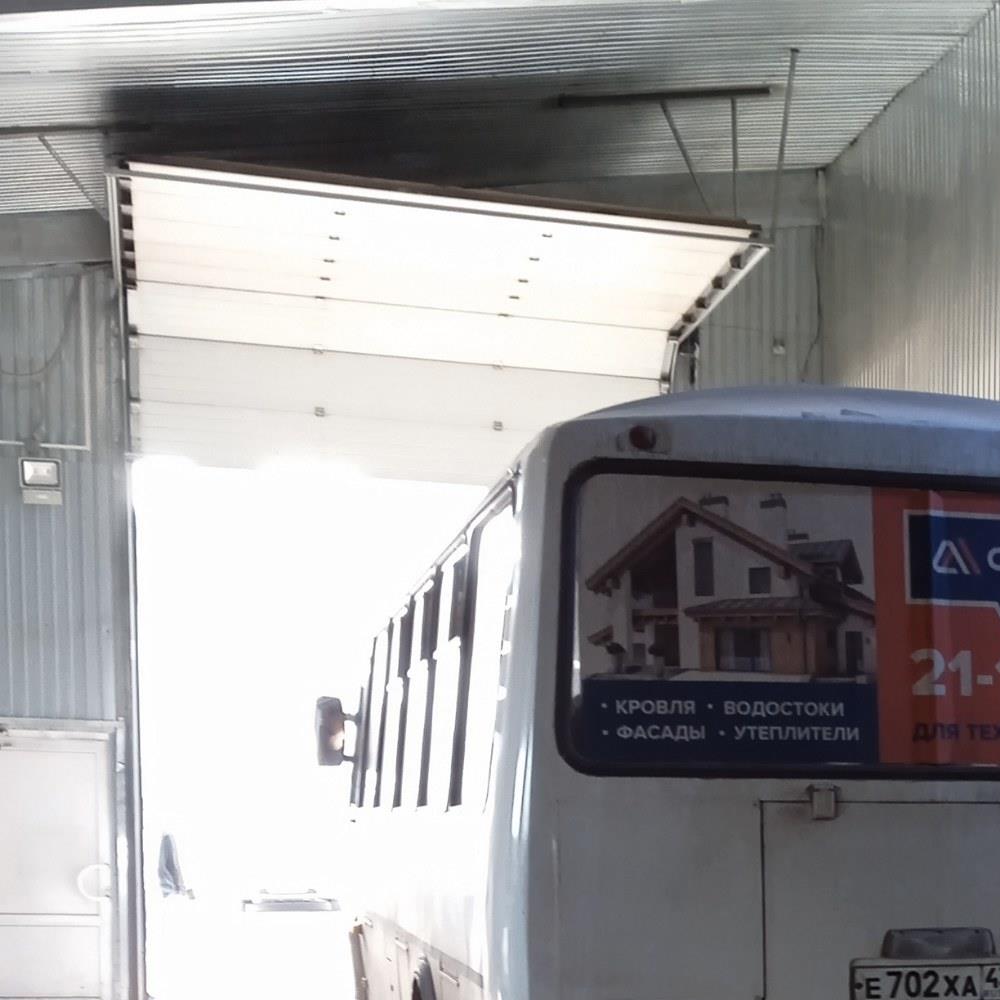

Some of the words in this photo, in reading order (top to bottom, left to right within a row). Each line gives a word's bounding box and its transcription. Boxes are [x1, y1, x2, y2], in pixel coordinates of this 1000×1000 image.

[615, 699, 696, 715] КРОВЛЯ
[723, 700, 845, 717] ВОДОСТОКИ
[616, 725, 706, 742] ФАСАДЫ
[734, 725, 860, 741] УТЕПЛИТЕЛИ
[912, 722, 960, 744] ДЛЯ
